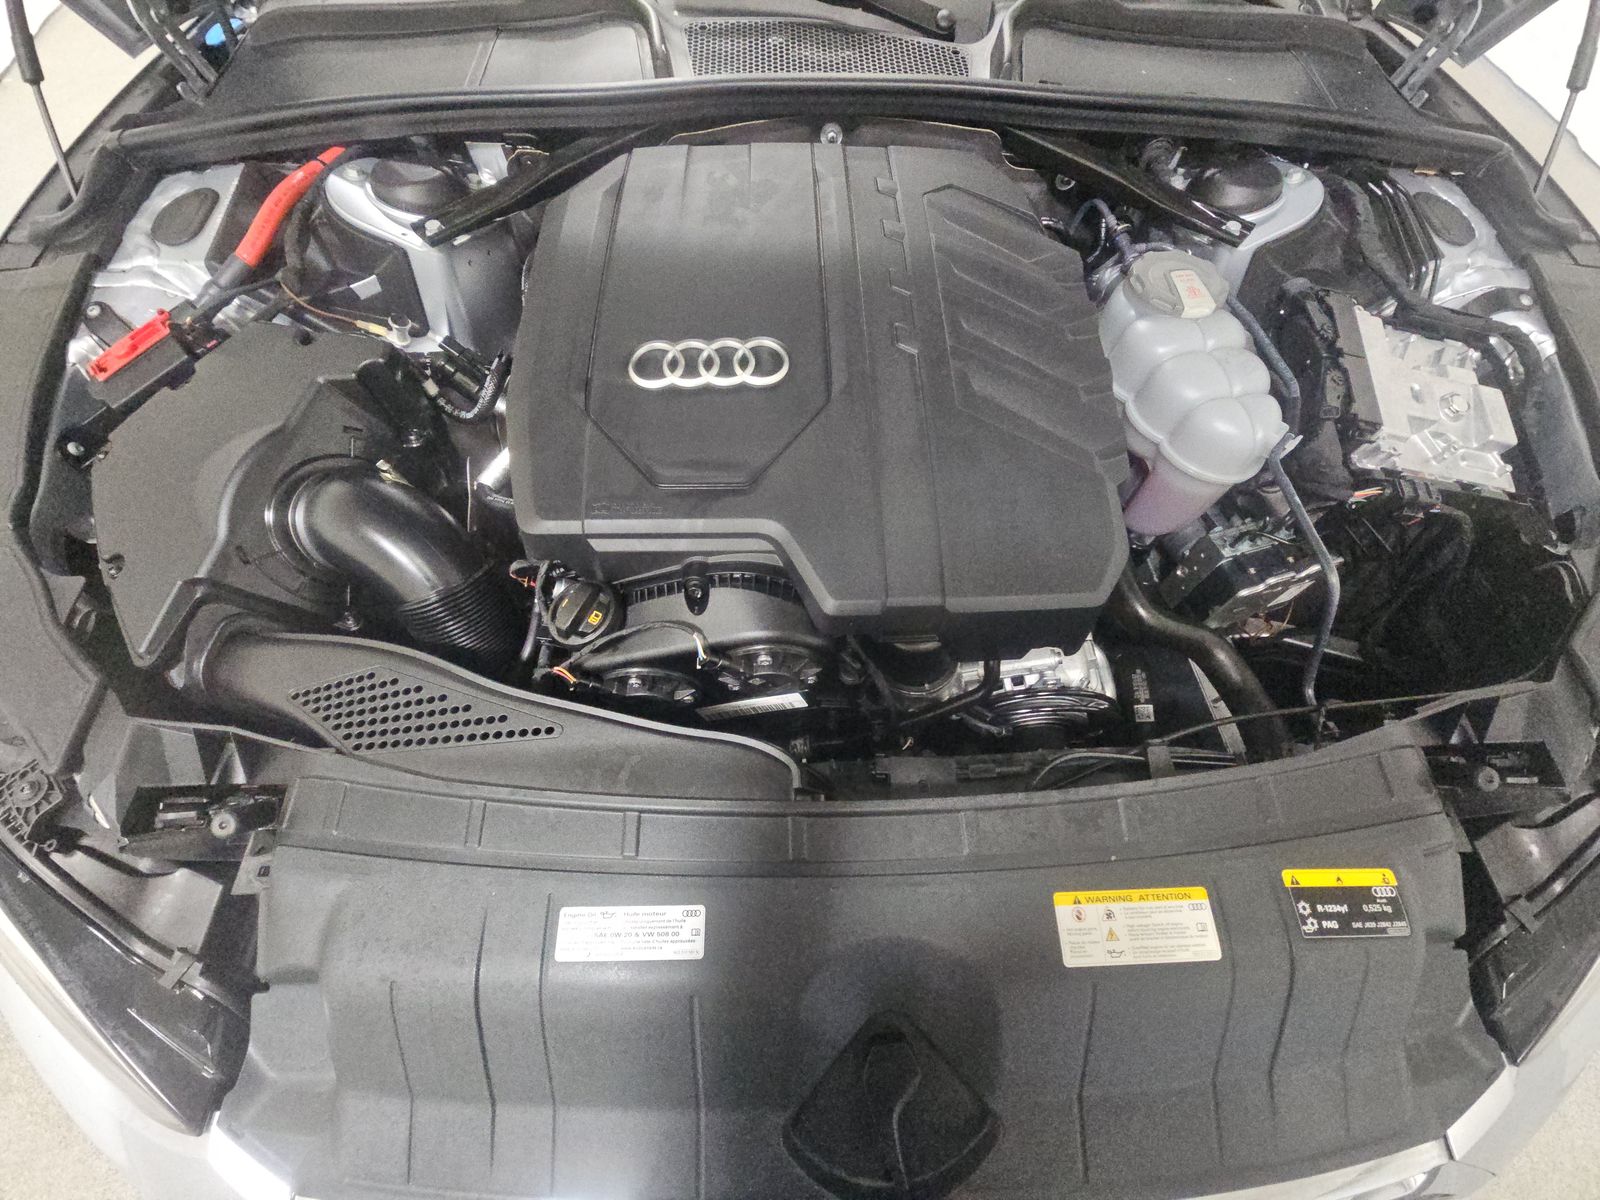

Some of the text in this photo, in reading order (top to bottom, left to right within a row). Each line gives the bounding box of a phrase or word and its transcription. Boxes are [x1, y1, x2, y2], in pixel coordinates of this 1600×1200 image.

[1084, 892, 1191, 904] WARNING ATTENTION
[1316, 903, 1393, 914] R-1234yf 0,525 kg
[563, 911, 586, 919] Engine
[1321, 920, 1339, 929] PAG
